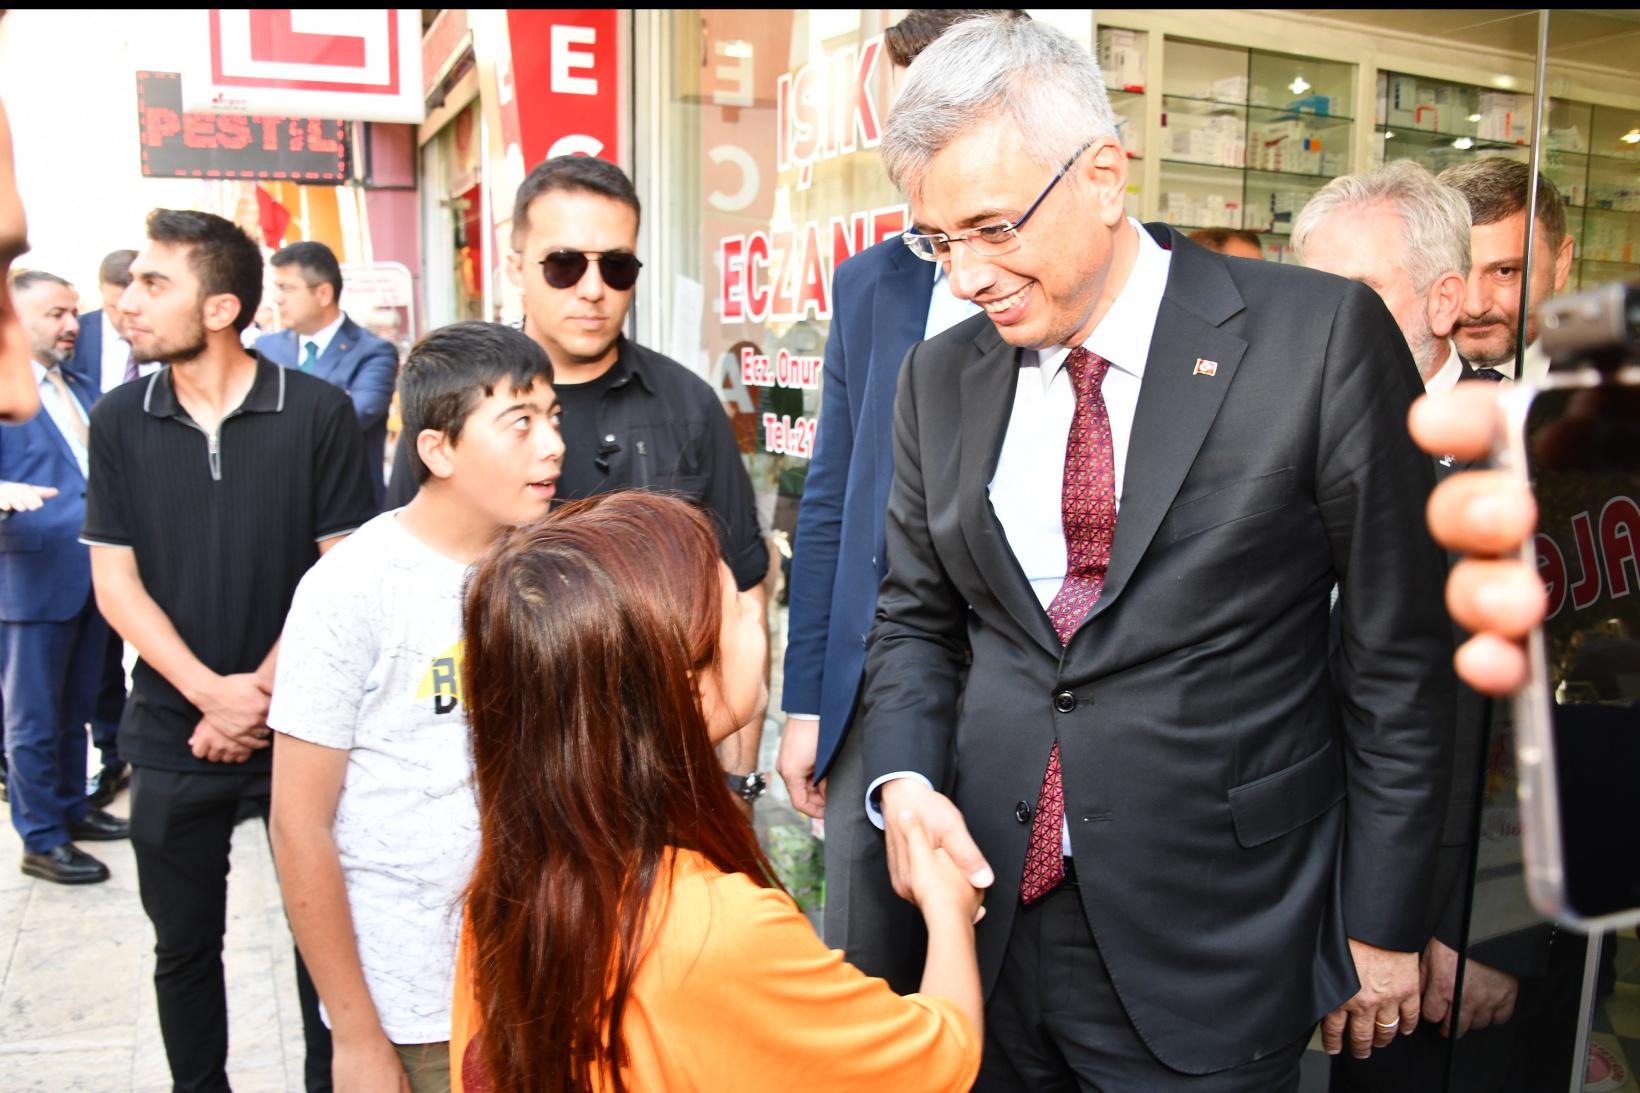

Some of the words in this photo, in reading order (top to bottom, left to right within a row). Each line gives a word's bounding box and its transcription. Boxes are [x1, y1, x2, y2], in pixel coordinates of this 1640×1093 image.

[777, 33, 884, 190] IŞIK
[741, 346, 776, 387] Ecz.
[777, 348, 823, 390] Onur
